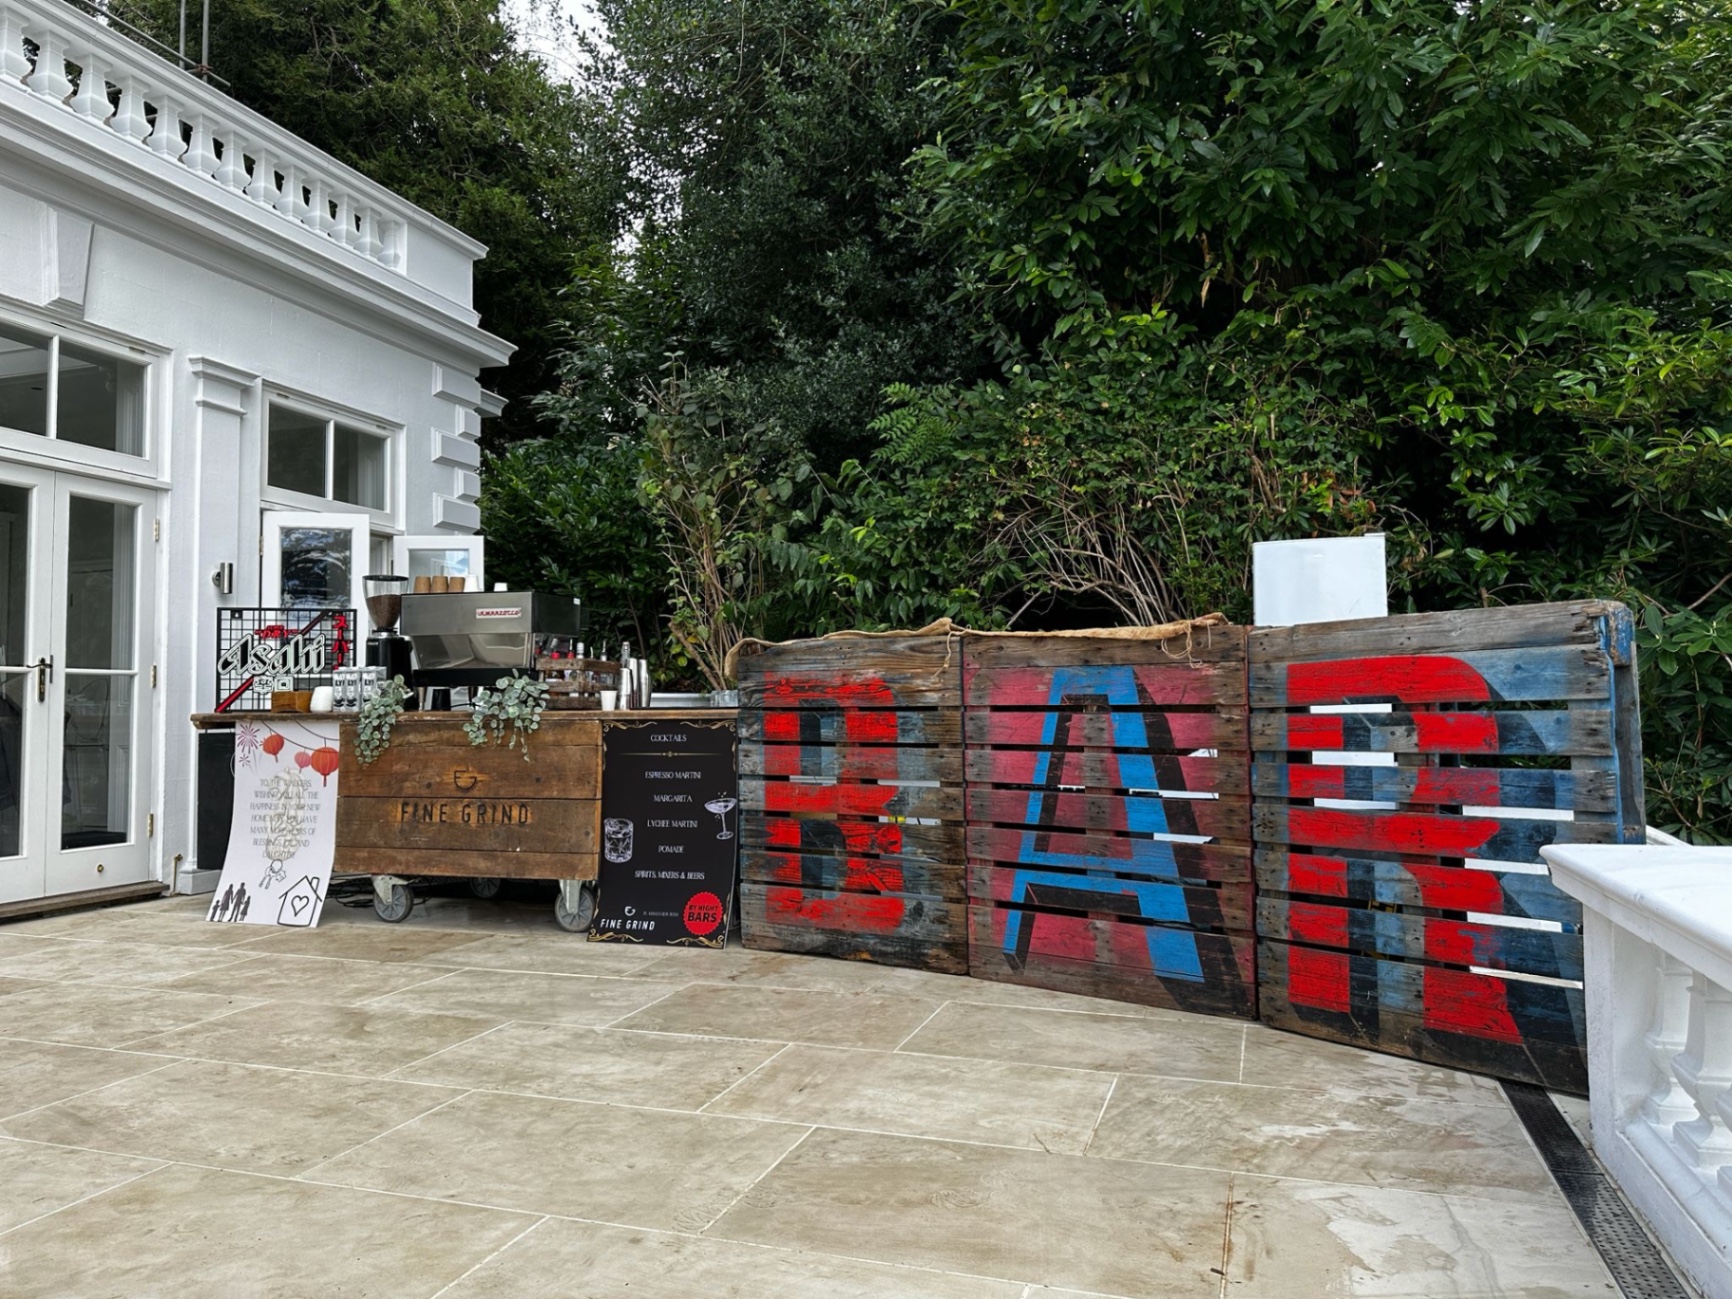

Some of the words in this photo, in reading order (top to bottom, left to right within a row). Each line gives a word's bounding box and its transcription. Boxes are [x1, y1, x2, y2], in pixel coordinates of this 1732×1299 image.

[217, 633, 326, 675] Asahi
[650, 734, 687, 742] COCKTAILS
[645, 771, 674, 779] ESPRESSO
[307, 791, 319, 799] THE
[653, 794, 693, 802] MARGARITA
[250, 802, 280, 811] HAPPINESS
[306, 803, 321, 811] NEW
[401, 803, 448, 823] FINE
[462, 804, 529, 824] GRIND
[647, 819, 670, 827] LYCHEE
[671, 820, 698, 828] MARTINI
[308, 827, 316, 835] OF
[658, 845, 684, 853] POMADE
[764, 655, 1524, 1044] BAR
[658, 870, 679, 879] MIXERS
[680, 871, 685, 879] &
[687, 872, 705, 880] BEERS
[687, 912, 717, 923] BARS
[600, 919, 622, 929] FINE
[626, 920, 655, 931] GRIND
